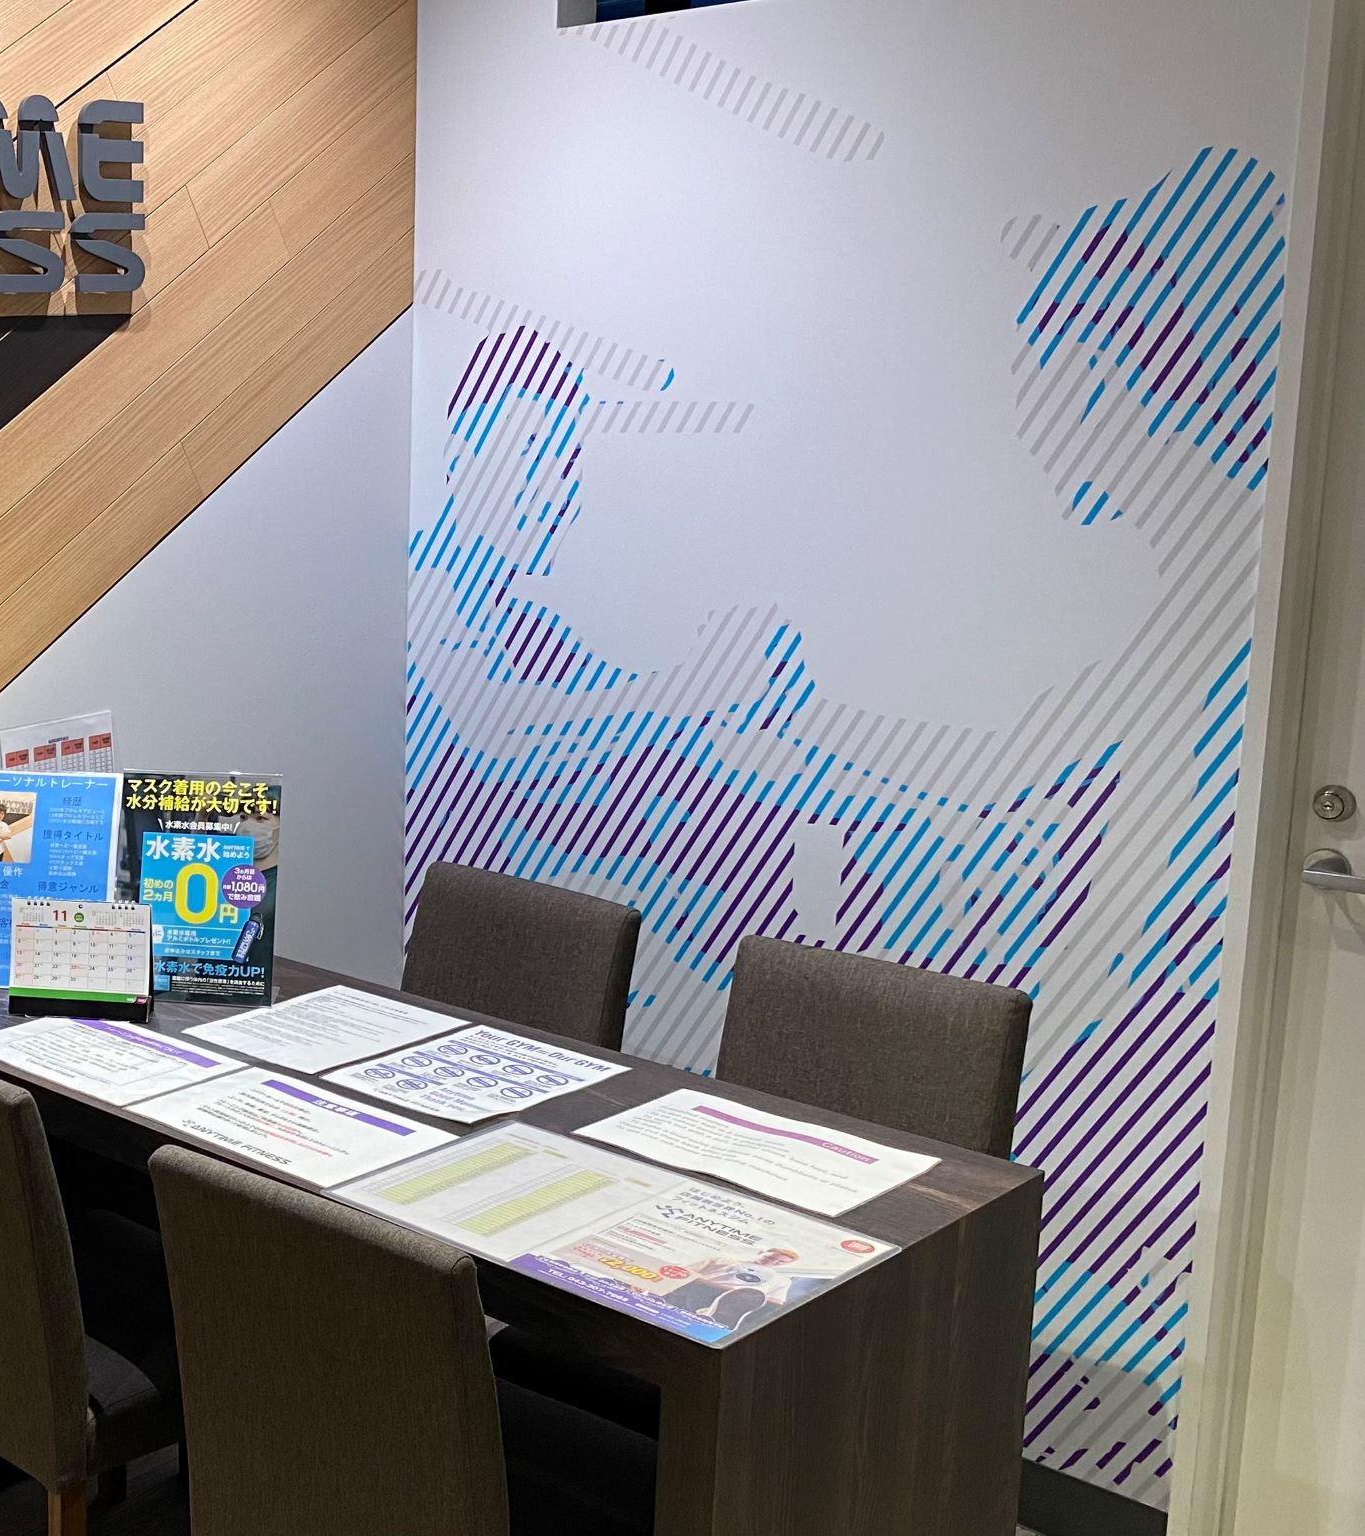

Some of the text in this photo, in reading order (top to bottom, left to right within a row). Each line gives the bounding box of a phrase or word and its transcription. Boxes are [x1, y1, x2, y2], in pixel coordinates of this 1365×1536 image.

[127, 779, 268, 799] マスク着用の今こそ
[126, 794, 277, 815] 水分補給が大切です!
[146, 836, 221, 862] 水素水
[38, 881, 99, 893] 得意ジャンル
[175, 863, 219, 924] 0
[219, 904, 239, 924] 円
[53, 910, 67, 921] 11
[155, 960, 265, 978] 水素水で免疫力UP!
[475, 1029, 503, 1042] Your
[507, 1037, 537, 1052] GYM
[549, 1051, 576, 1065] Our
[577, 1058, 612, 1073] GYM
[191, 1119, 292, 1166] ANYTIME FITNESS
[821, 1140, 871, 1164] Caution
[676, 1216, 756, 1246] FITNESS
[685, 1212, 763, 1242] ANYTIME
